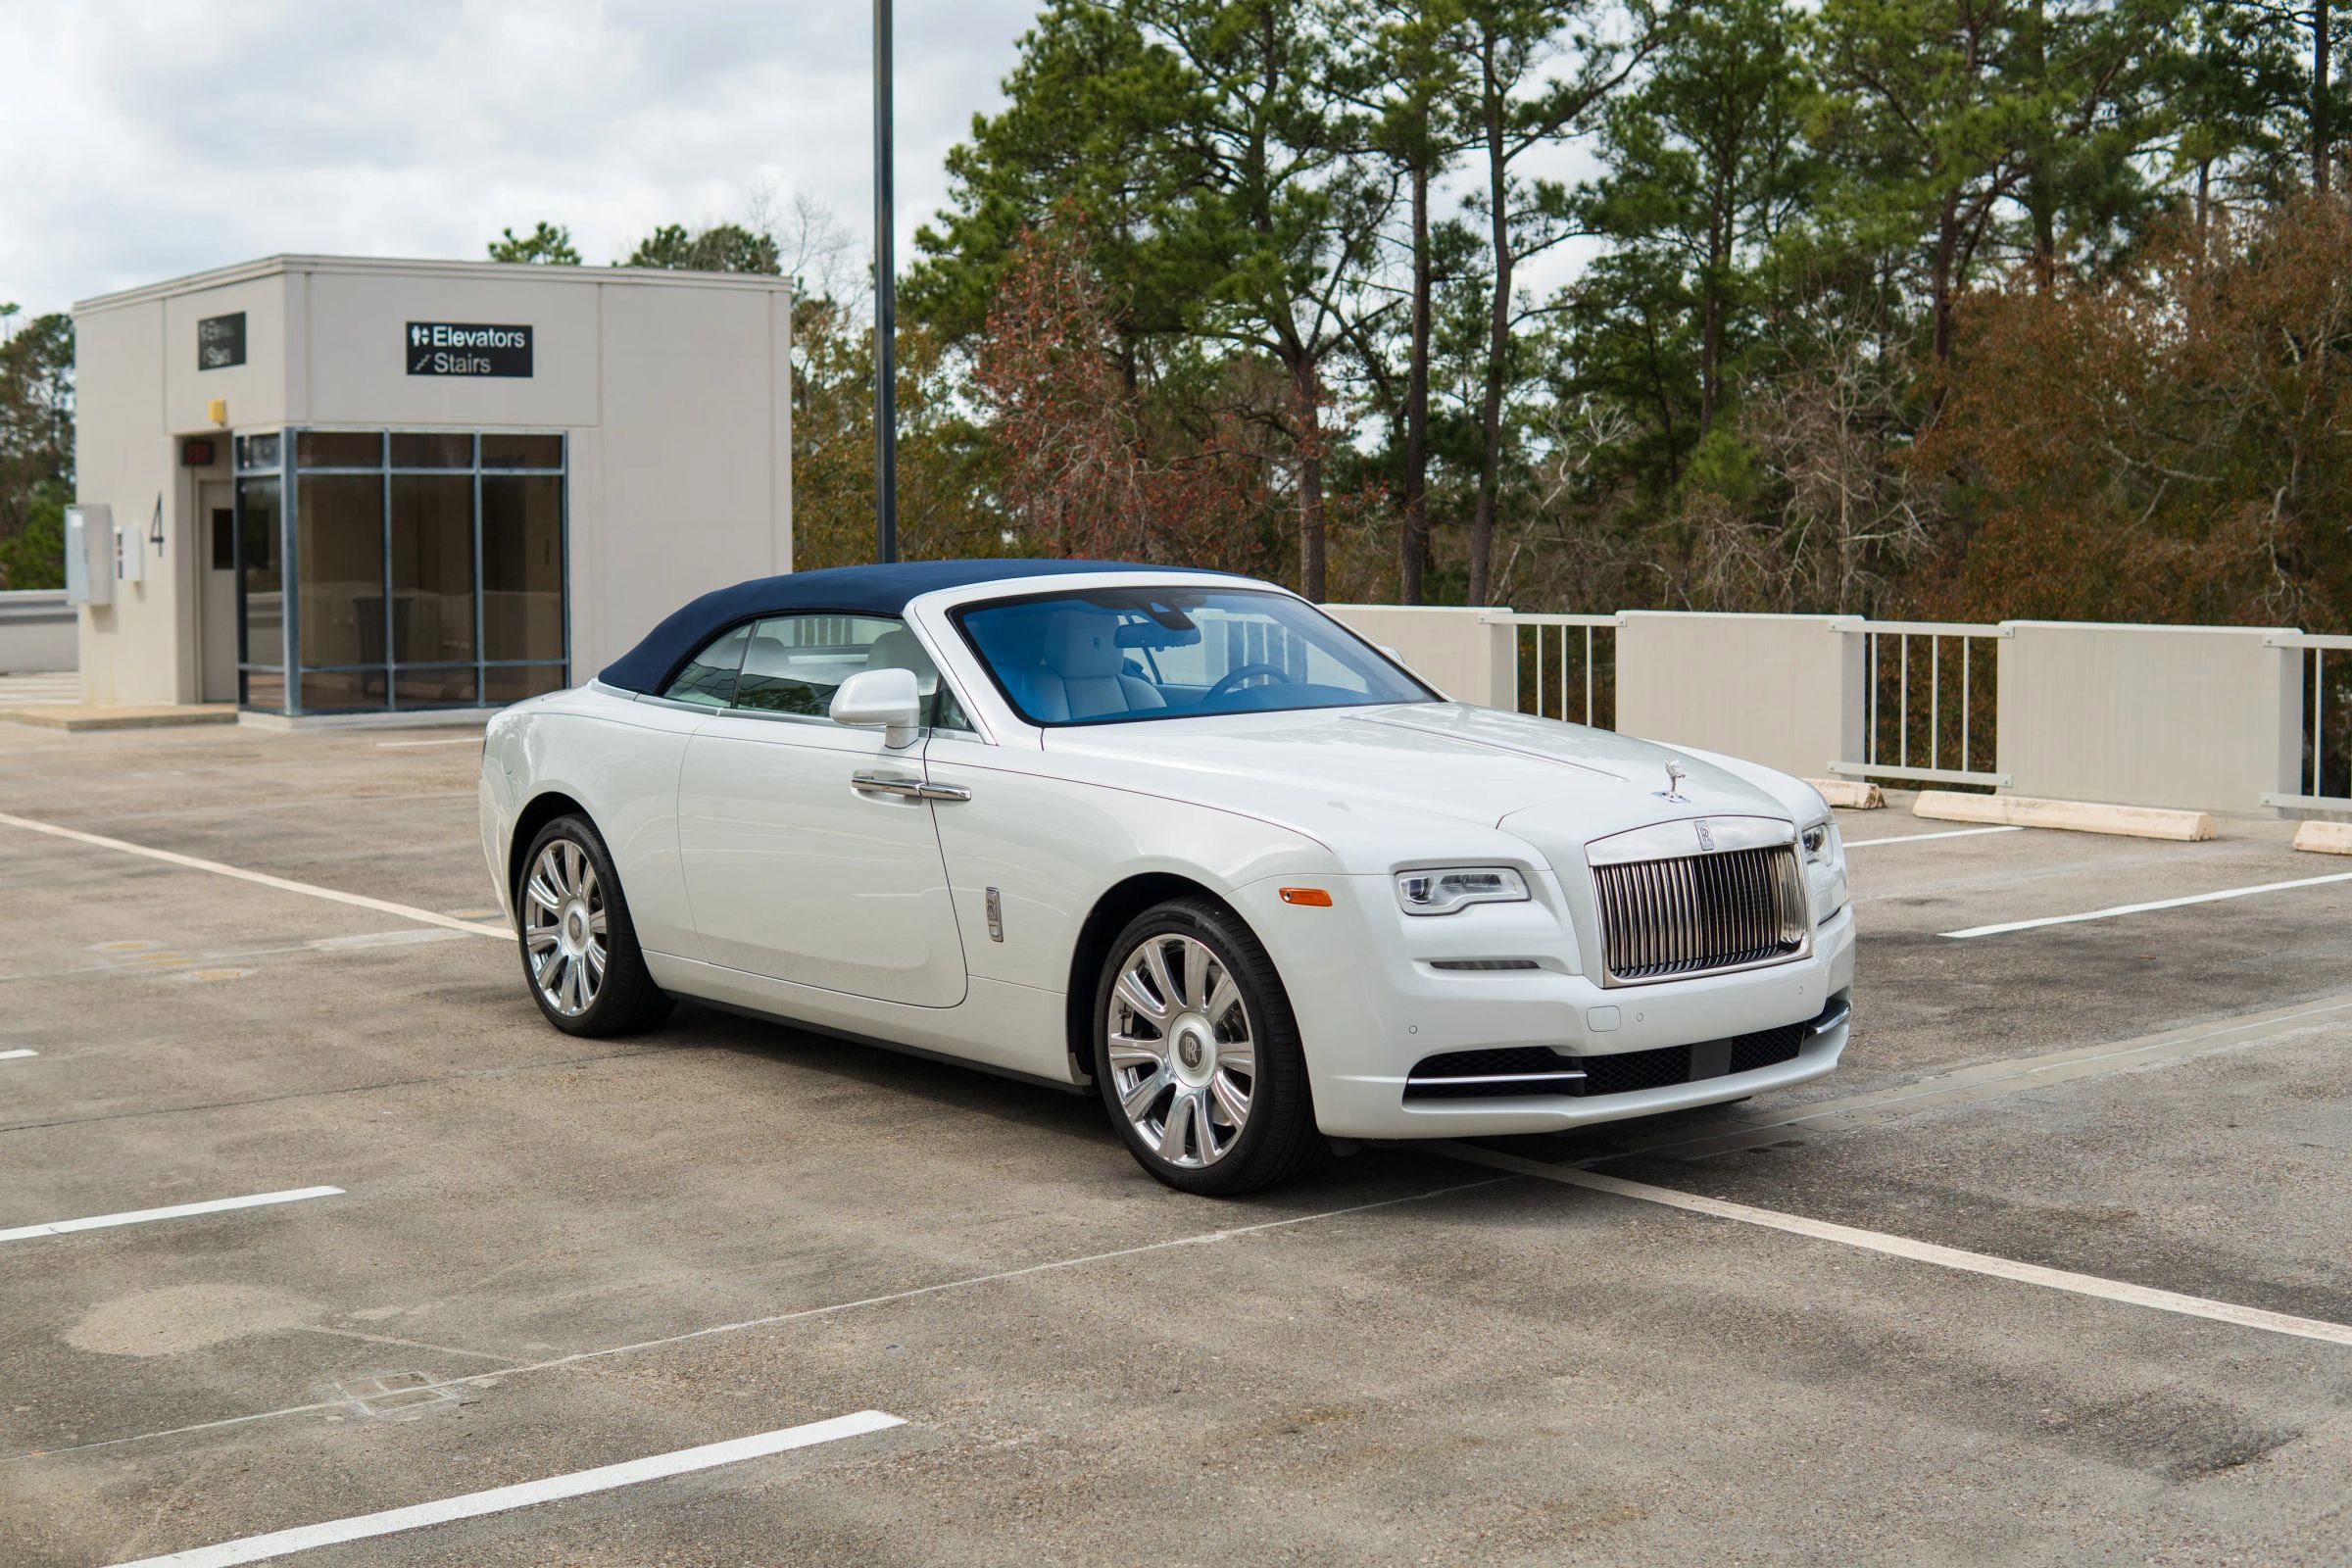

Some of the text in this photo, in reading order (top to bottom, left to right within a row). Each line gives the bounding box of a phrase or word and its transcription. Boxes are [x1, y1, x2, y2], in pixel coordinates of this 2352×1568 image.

[433, 326, 525, 348] Elevators
[434, 352, 491, 373] Stairs
[149, 491, 165, 558] 4
